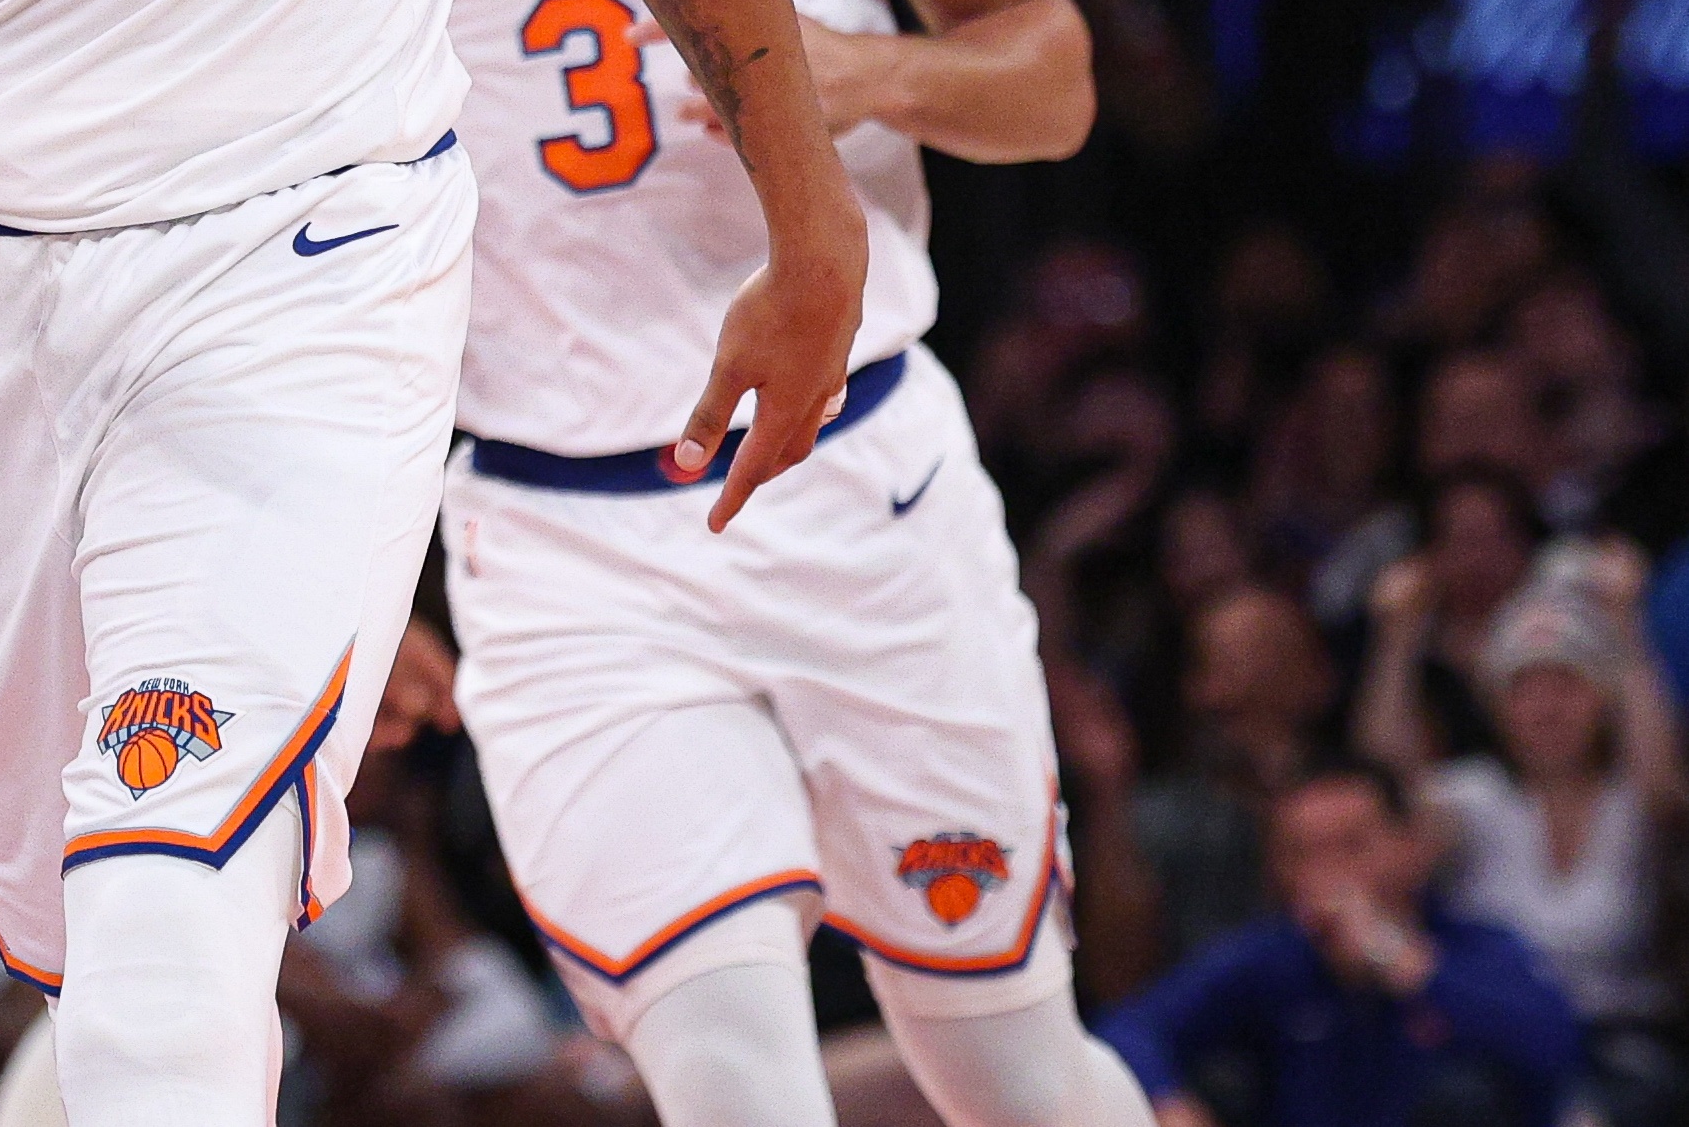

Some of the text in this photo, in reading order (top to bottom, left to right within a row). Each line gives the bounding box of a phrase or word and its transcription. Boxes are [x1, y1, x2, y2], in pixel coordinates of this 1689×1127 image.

[138, 677, 190, 695] NEW YORK
[96, 688, 223, 751] KNICKS
